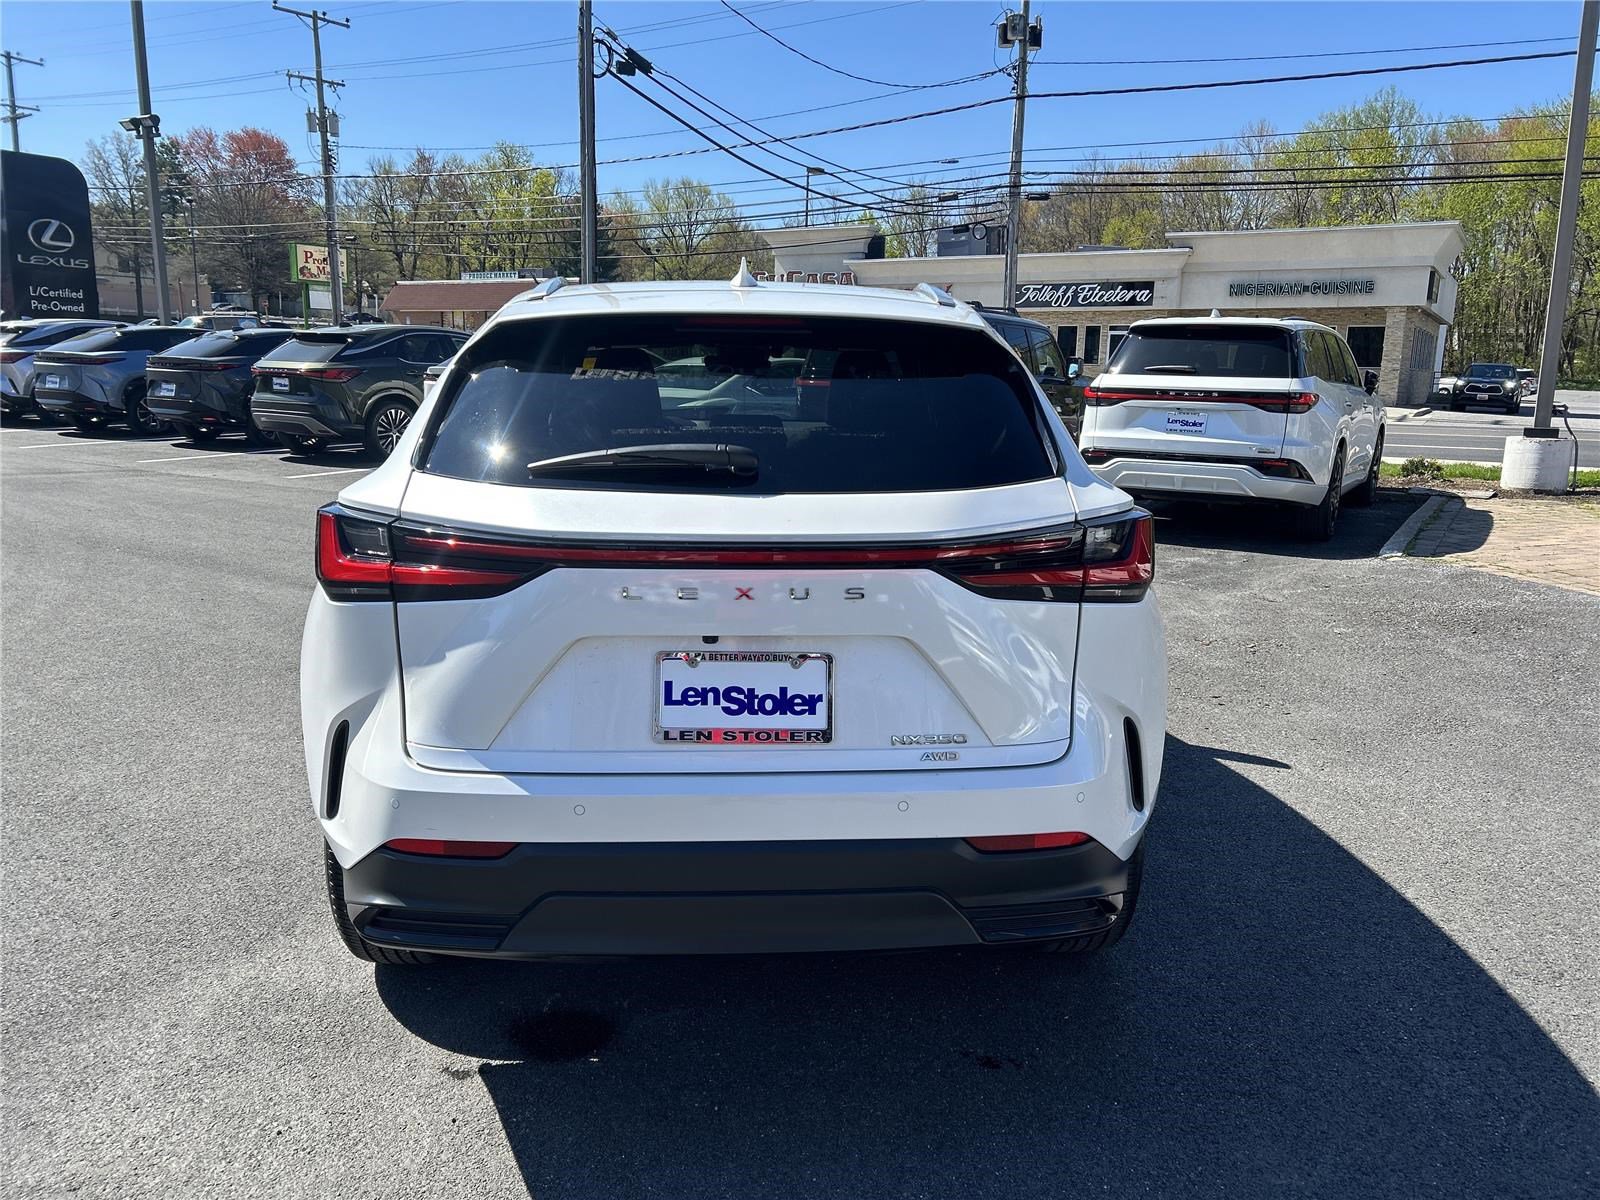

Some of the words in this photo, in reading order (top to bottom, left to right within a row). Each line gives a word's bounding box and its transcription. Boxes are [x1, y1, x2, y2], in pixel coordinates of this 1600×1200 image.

[17, 254, 89, 269] LEXUS
[303, 250, 345, 268] Prode
[29, 285, 84, 299] L/Certified
[1077, 283, 1153, 304] Etcetera
[1229, 282, 1304, 297] NIGERIAN
[1310, 280, 1375, 295] CUISINE
[31, 300, 85, 313] Pre-Owned
[621, 586, 866, 601] LEXUS
[708, 653, 739, 662] BETTER
[740, 653, 758, 662] WAY
[760, 654, 771, 662] TO
[772, 653, 787, 662] BUY
[663, 730, 713, 741] LEN
[722, 730, 824, 742] STOLER
[890, 734, 968, 746] NX350
[920, 751, 960, 761] AWD
